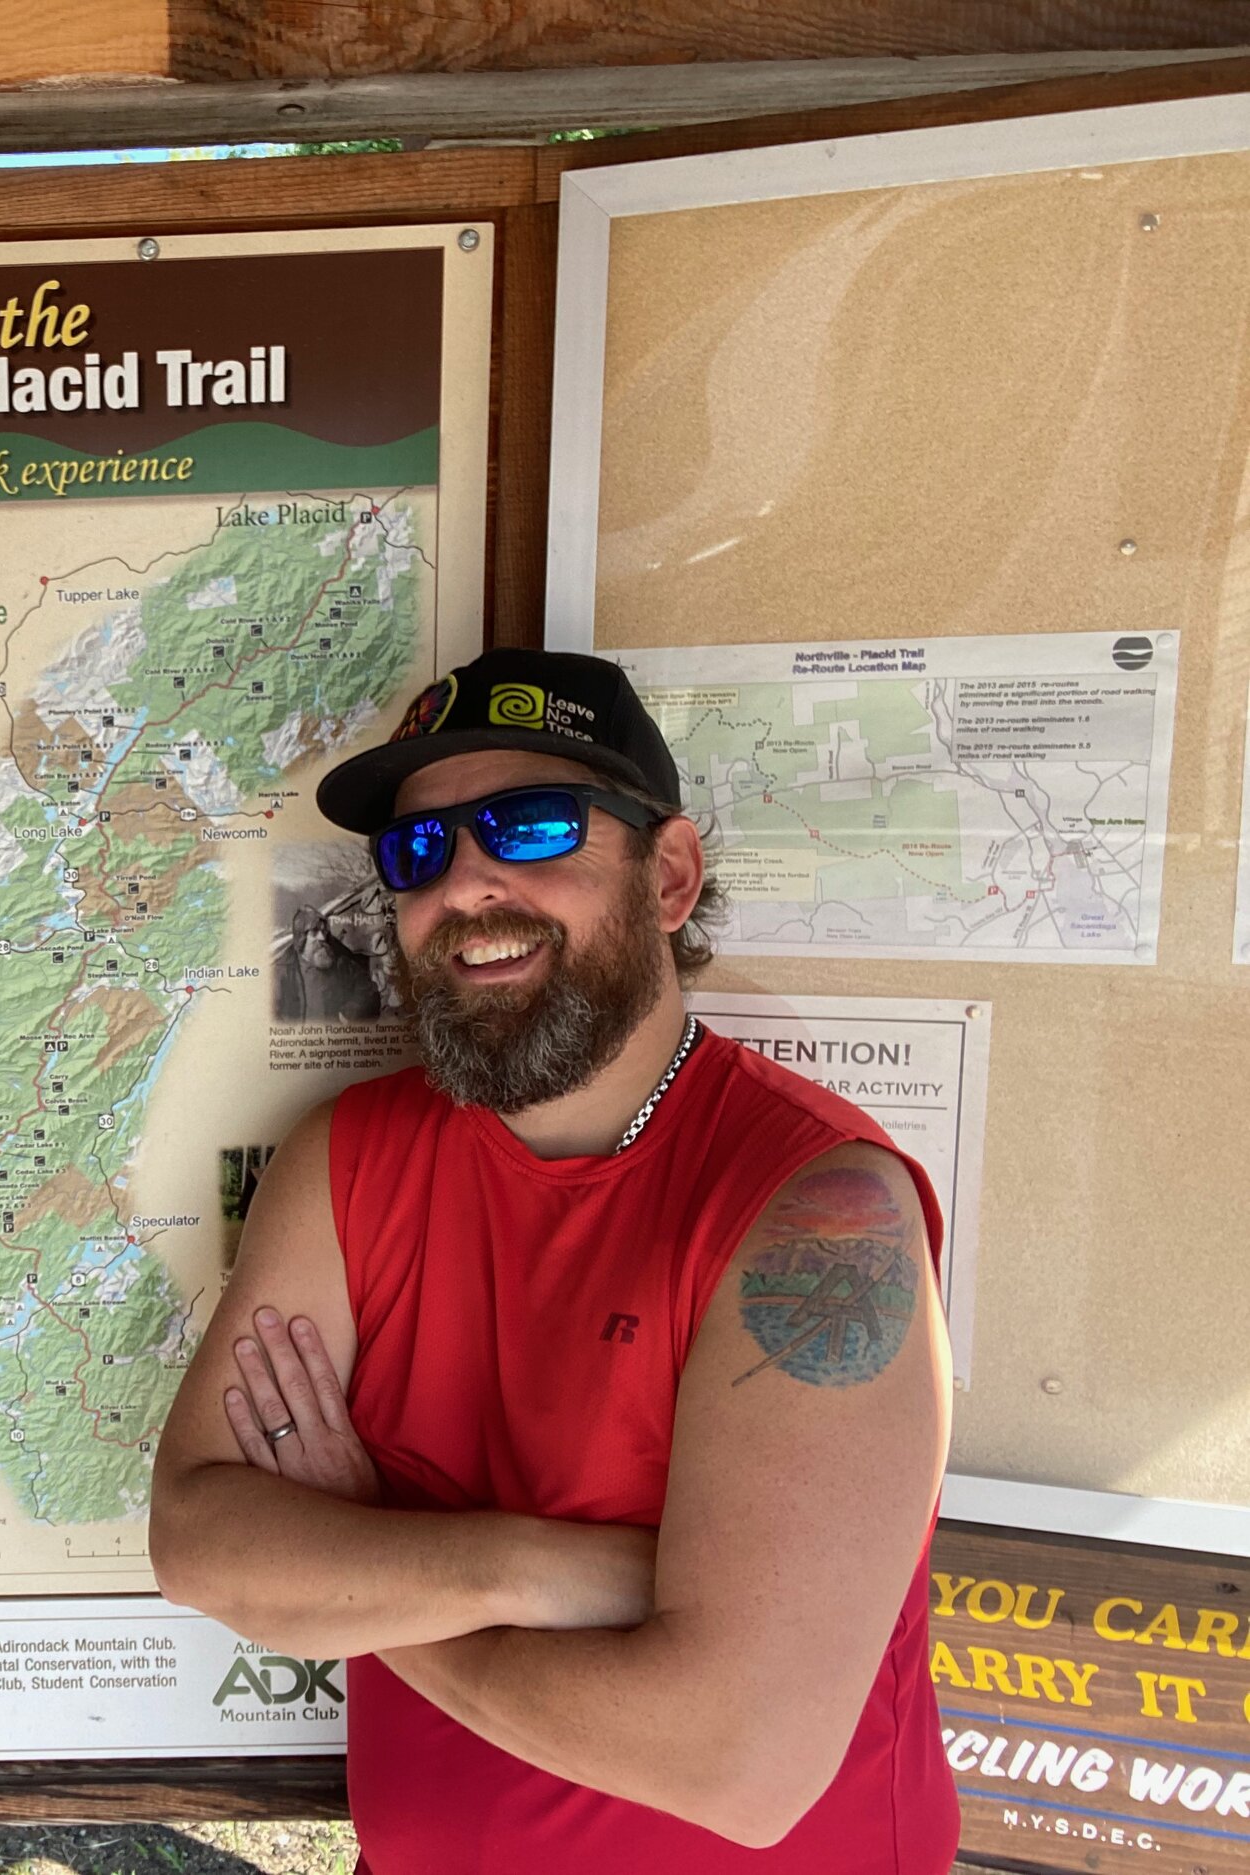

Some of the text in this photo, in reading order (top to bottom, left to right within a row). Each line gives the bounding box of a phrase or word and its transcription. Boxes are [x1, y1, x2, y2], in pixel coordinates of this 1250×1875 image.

[156, 346, 286, 407] Trail
[21, 449, 193, 496] experience
[215, 501, 346, 528] Lake Placid
[56, 587, 139, 603] Tupper Lake
[795, 649, 924, 661] Northville Placid Trail
[792, 661, 926, 674] Re-Route Location Map
[548, 692, 595, 721] Leave
[546, 708, 571, 724] No
[547, 720, 593, 742] Trace
[14, 826, 82, 841] Long Lake
[203, 827, 267, 841] Newcomb
[64, 870, 78, 881] 30
[146, 960, 157, 970] 28
[185, 966, 260, 978] Indian Lake
[731, 1037, 911, 1066] TENTION!
[270, 1059, 381, 1071] former site of his cabin.
[857, 1081, 943, 1097] ACTIVITY
[100, 1117, 113, 1127] 30
[132, 1215, 200, 1228] Speculator
[75, 1275, 82, 1284] 8
[932, 1572, 1065, 1630] YOU
[75, 1637, 137, 1652] Mountain
[143, 1637, 176, 1651] Club.
[25, 1657, 116, 1673] Conservation,
[121, 1656, 150, 1669] with
[155, 1655, 176, 1669] the
[32, 1676, 83, 1690] Student
[90, 1674, 177, 1689] Conservation
[213, 1656, 346, 1706] ADK
[1136, 1671, 1206, 1723] IT
[220, 1707, 339, 1722] Mountain Club
[1003, 1809, 1161, 1851] N.Y.S.D.E.C.
